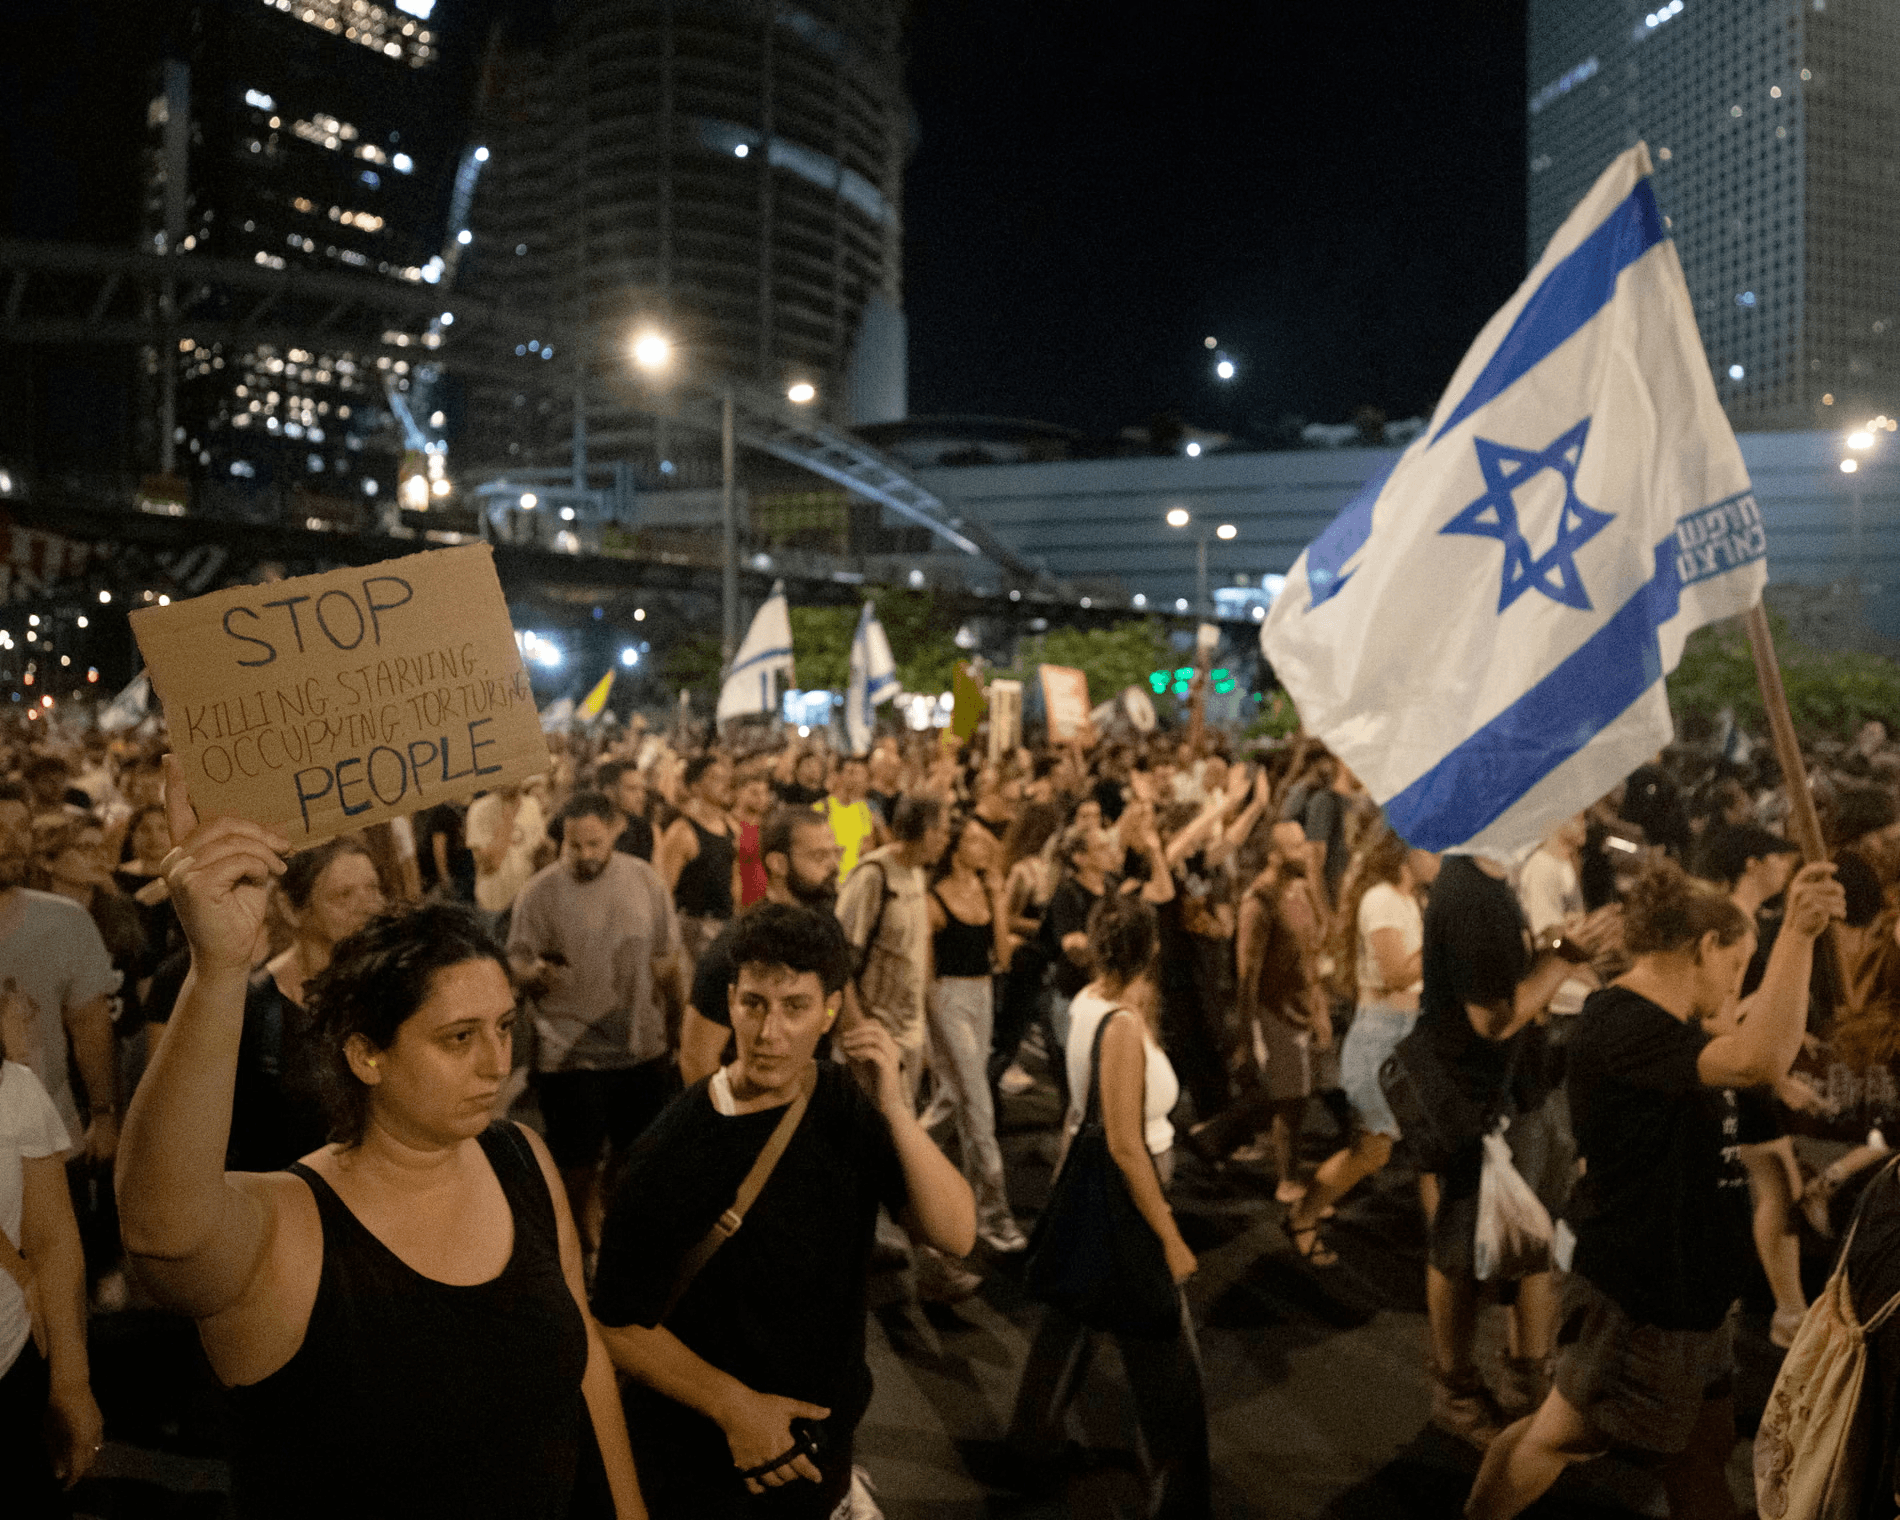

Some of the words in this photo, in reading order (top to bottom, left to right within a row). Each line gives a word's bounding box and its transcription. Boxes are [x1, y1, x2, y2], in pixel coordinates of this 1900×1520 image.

[222, 576, 414, 668] STOP
[406, 671, 529, 730] TORTURING
[294, 717, 503, 834] PEOPLE
